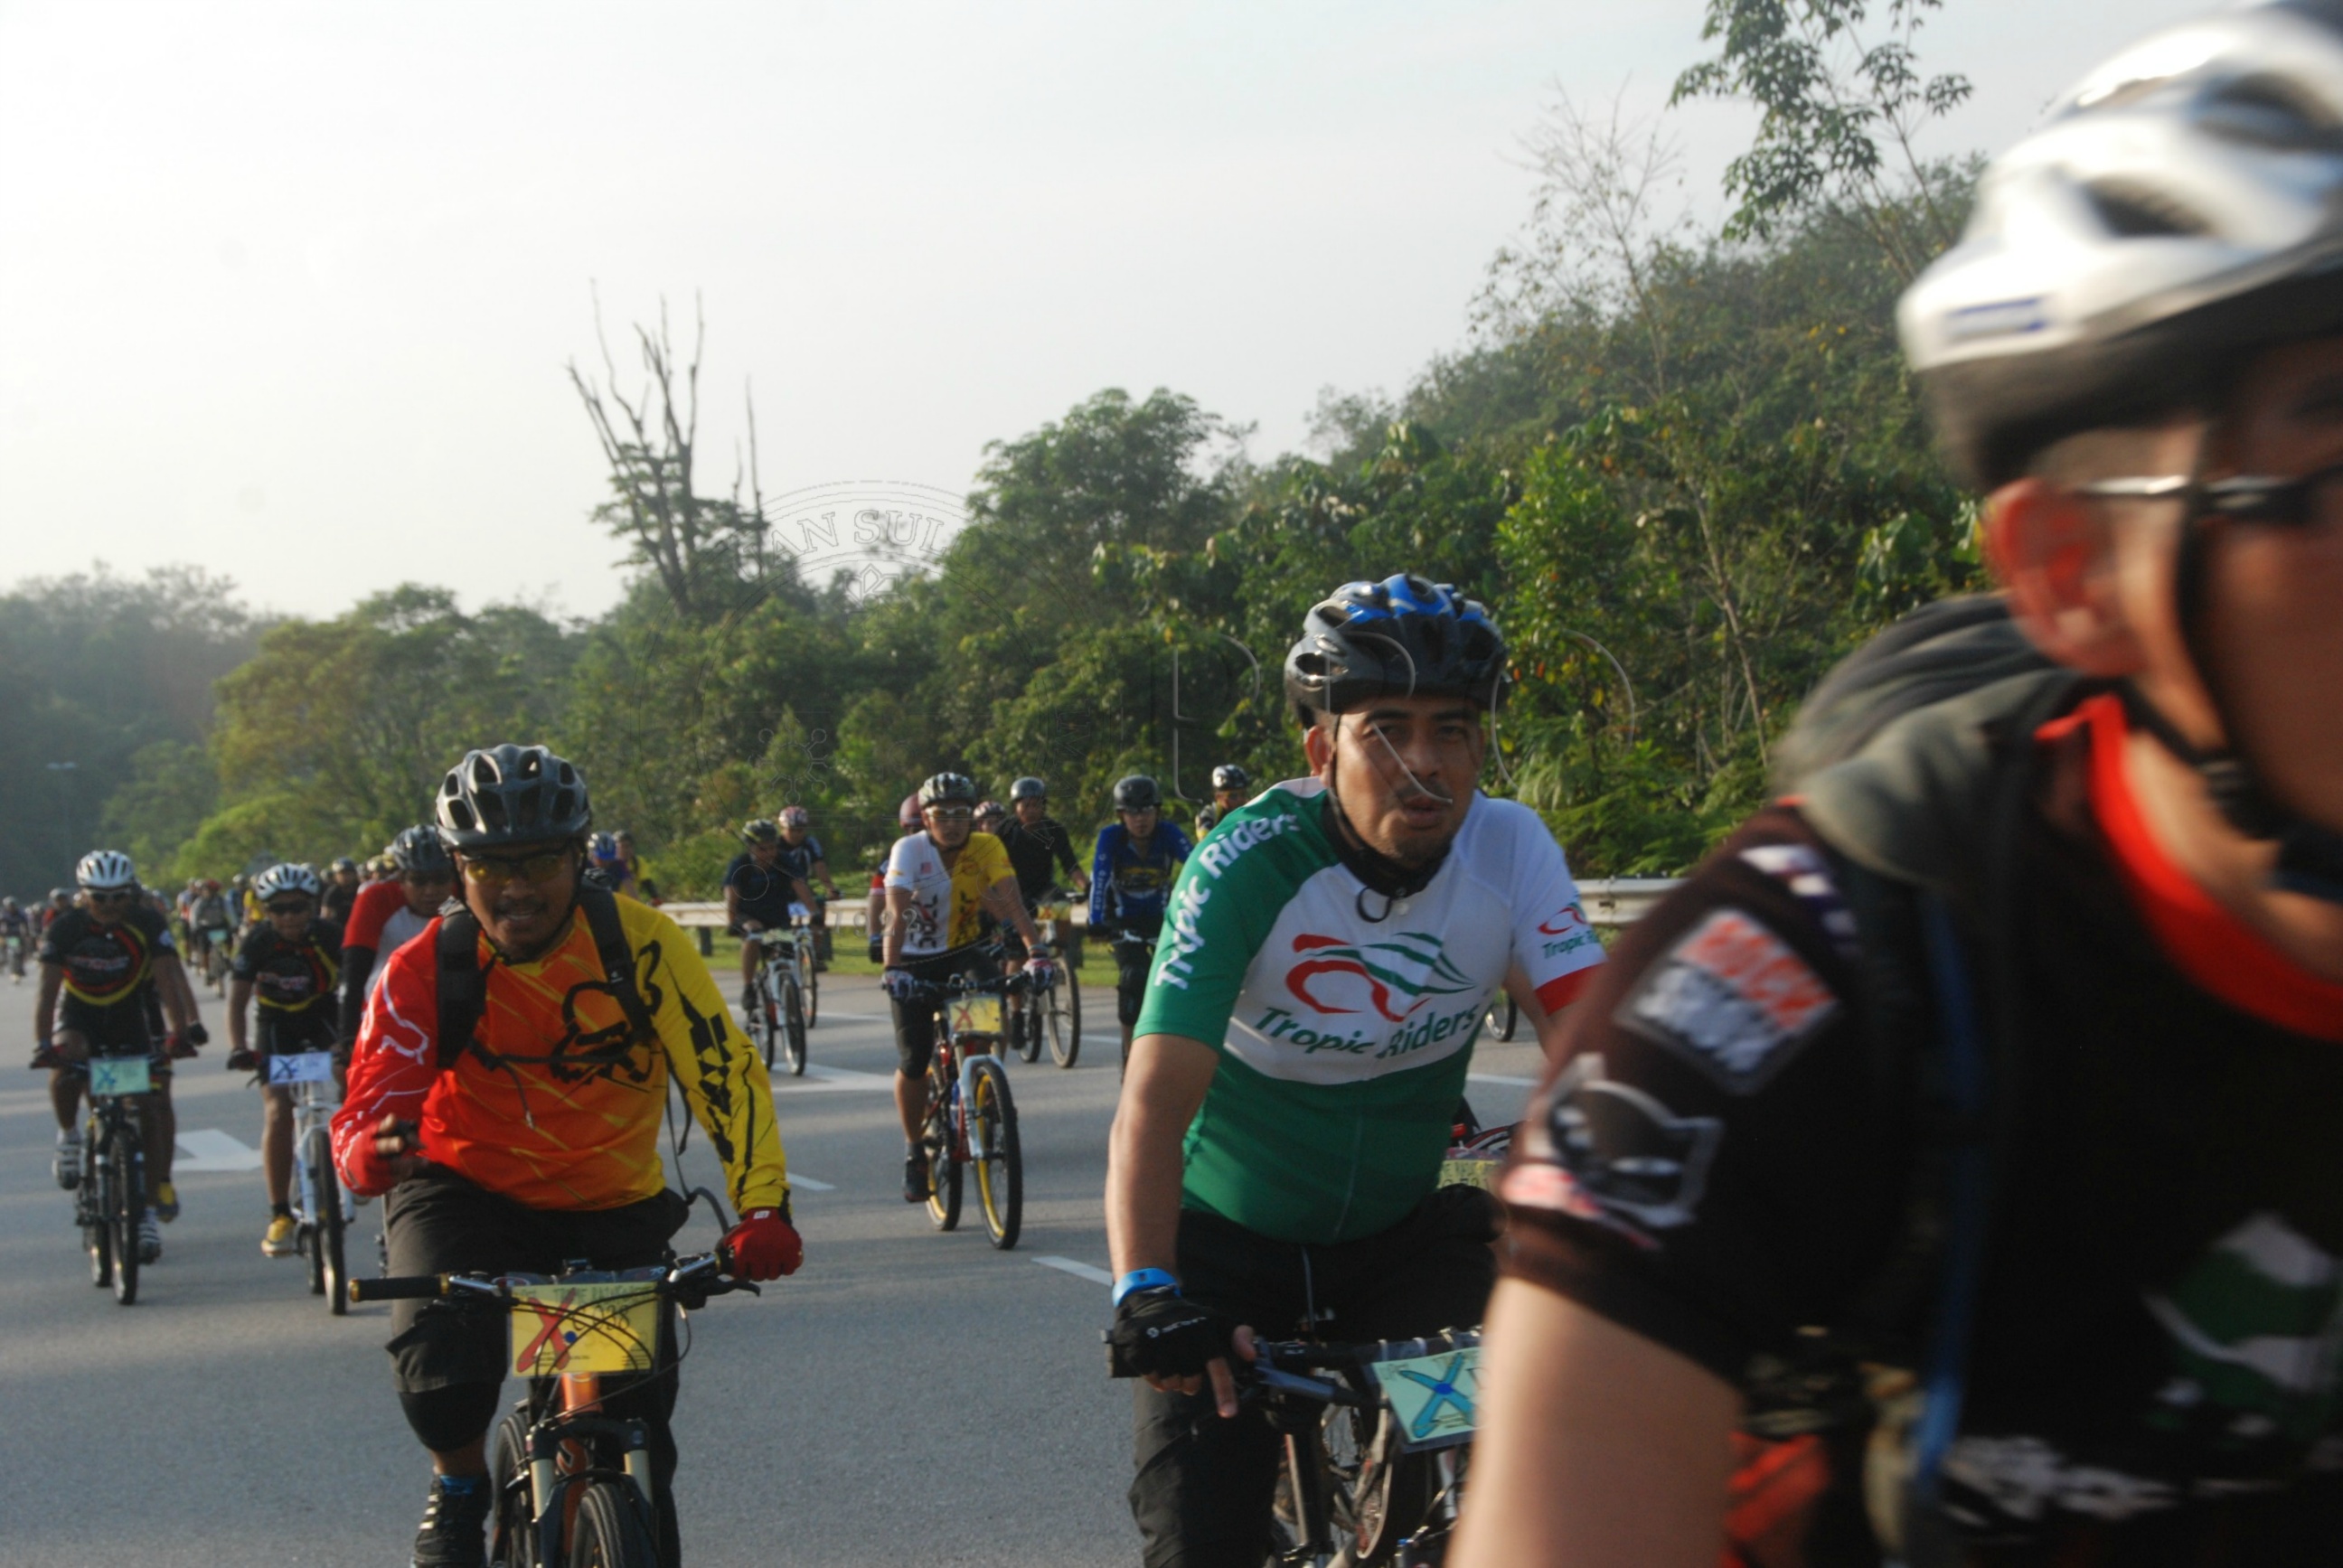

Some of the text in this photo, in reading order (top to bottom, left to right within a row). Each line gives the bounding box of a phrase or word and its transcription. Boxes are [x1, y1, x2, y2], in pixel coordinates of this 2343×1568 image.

[1154, 876, 1211, 990] Tropic
[1542, 932, 1586, 959] Tropic
[1255, 1003, 1480, 1059] Tropic Riders
